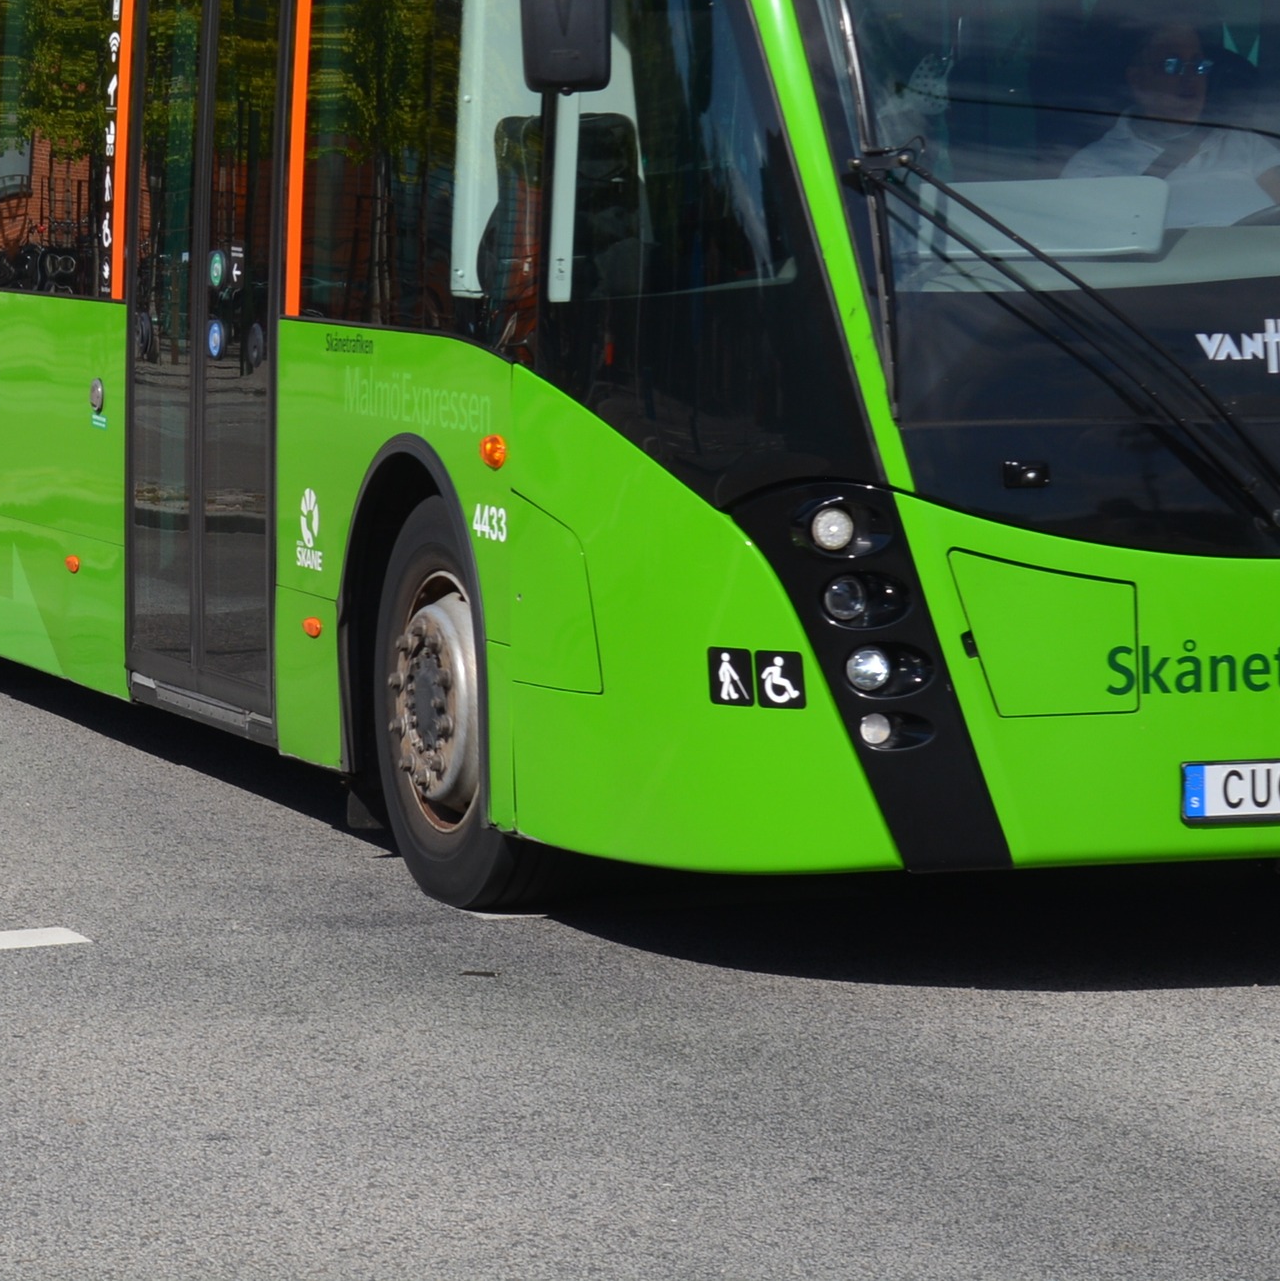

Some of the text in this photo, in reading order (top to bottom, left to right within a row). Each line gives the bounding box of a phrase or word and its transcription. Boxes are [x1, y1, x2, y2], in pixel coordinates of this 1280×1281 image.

[326, 332, 374, 354] Skånetrafiken
[344, 365, 491, 434] MalmöExpressen
[473, 503, 507, 542] 4433
[1190, 797, 1200, 808] S
